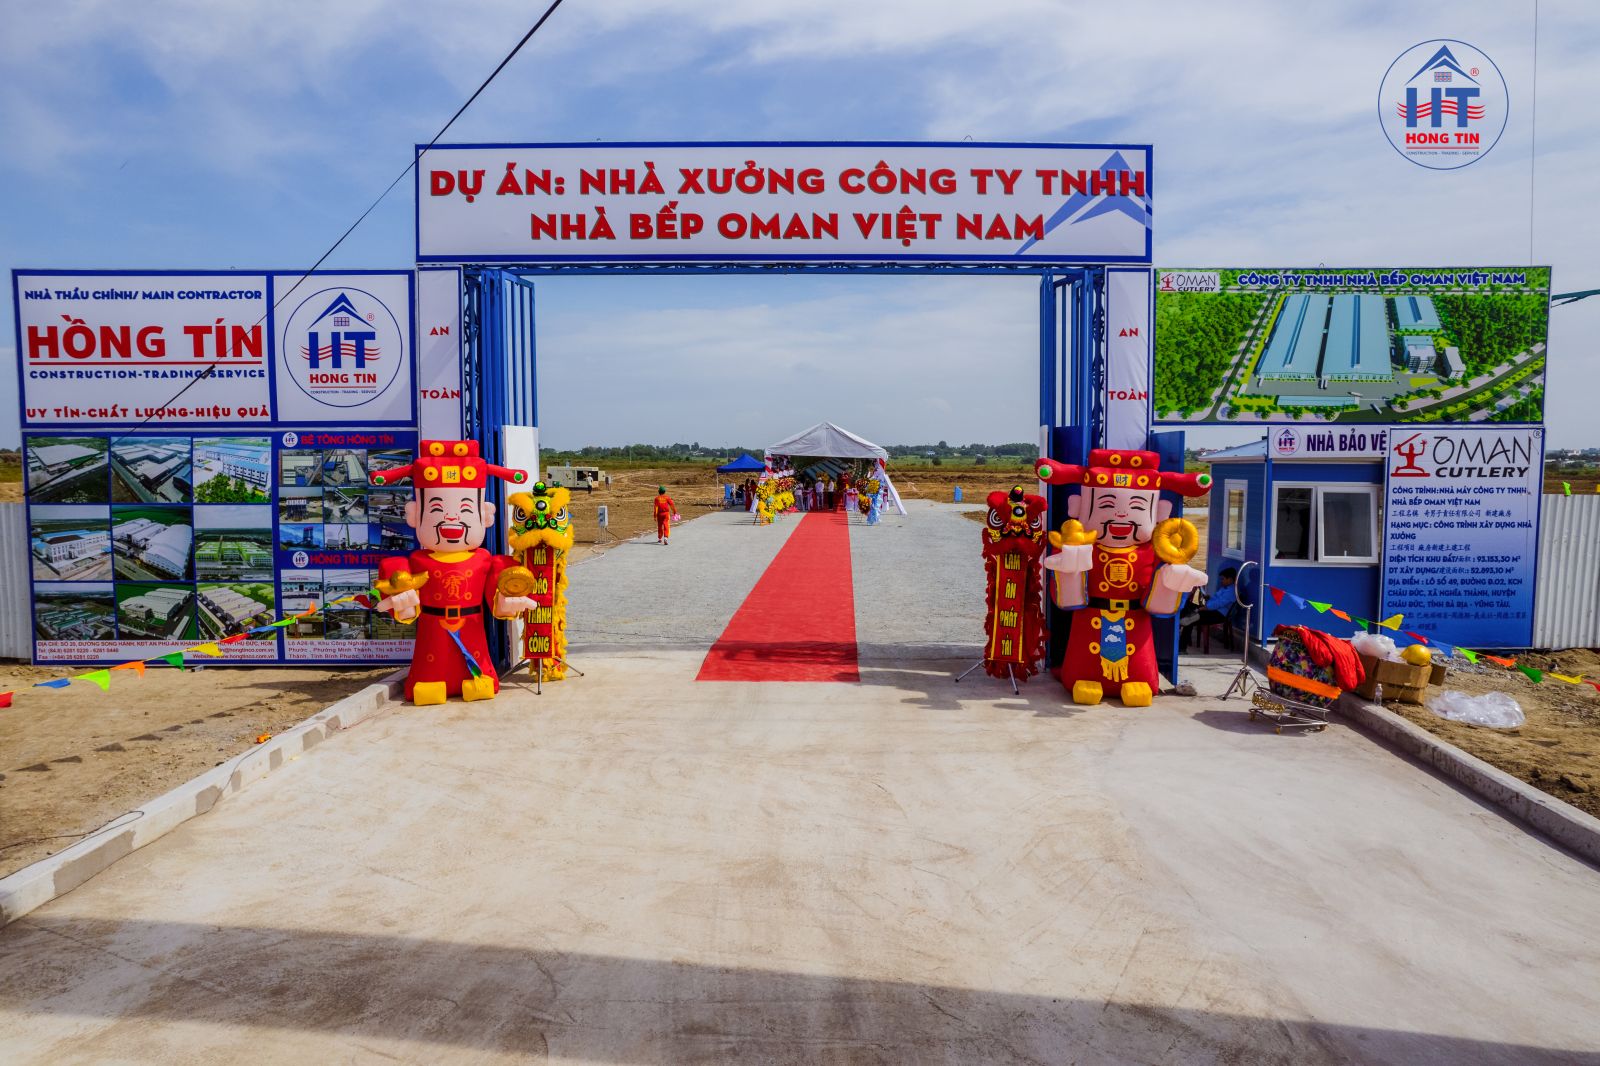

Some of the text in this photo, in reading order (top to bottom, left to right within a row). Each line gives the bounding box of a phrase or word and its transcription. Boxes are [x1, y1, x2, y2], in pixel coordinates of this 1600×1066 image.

[430, 160, 1145, 204] DỰ ÁN: NHÀ XƯỞNG CÔNG TY TNHH
[530, 201, 1044, 247] NHÀ BẾP OMAN VIỆT NAM
[1176, 274, 1216, 286] OMAN
[1238, 270, 1526, 287] CÔNG TY TNHH NHÀ BẾP OMAN VIỆT NAM
[25, 288, 52, 300] NHÀ
[92, 288, 139, 300] CHÍNH/
[142, 290, 174, 300] MAIN
[177, 290, 262, 300] CONTRACTOR
[27, 314, 263, 359] HỒNG TÍN
[430, 326, 449, 336] AN
[1119, 328, 1139, 337] AN
[308, 331, 375, 369] HT
[309, 373, 377, 384] HONG TIN
[421, 387, 460, 399] TOÀN
[1108, 388, 1148, 401] TOÀN
[27, 408, 47, 418] UY
[54, 403, 129, 418] TÍN-CHẤT
[237, 404, 269, 418] QUẢ
[316, 433, 345, 445] TÔNG
[1306, 428, 1388, 455] NHÀ BẢO VỆ
[1432, 436, 1532, 465] OMAN
[1435, 466, 1529, 478] CUTLERY
[1392, 485, 1413, 494] CÔNG
[1456, 485, 1471, 494] MÁY
[1473, 485, 1494, 494] CÔNG
[1391, 497, 1407, 505] NHÀ
[1408, 495, 1422, 505] BẾP
[1423, 498, 1446, 506] OMAN
[1447, 497, 1463, 507] VIỆT
[1390, 521, 1411, 530] HẠNG
[1433, 520, 1455, 528] CÔNG
[1456, 520, 1478, 528] TRÌNH
[1479, 519, 1494, 528] XÂY
[1495, 521, 1516, 531] DỰNG
[1517, 519, 1533, 528] NHÀ
[1389, 554, 1406, 564] DIỆN
[1407, 554, 1424, 562] TÍCH
[1400, 565, 1414, 574] XÂY
[1000, 606, 1018, 628] PHÁT
[528, 631, 550, 653] CÔNG
